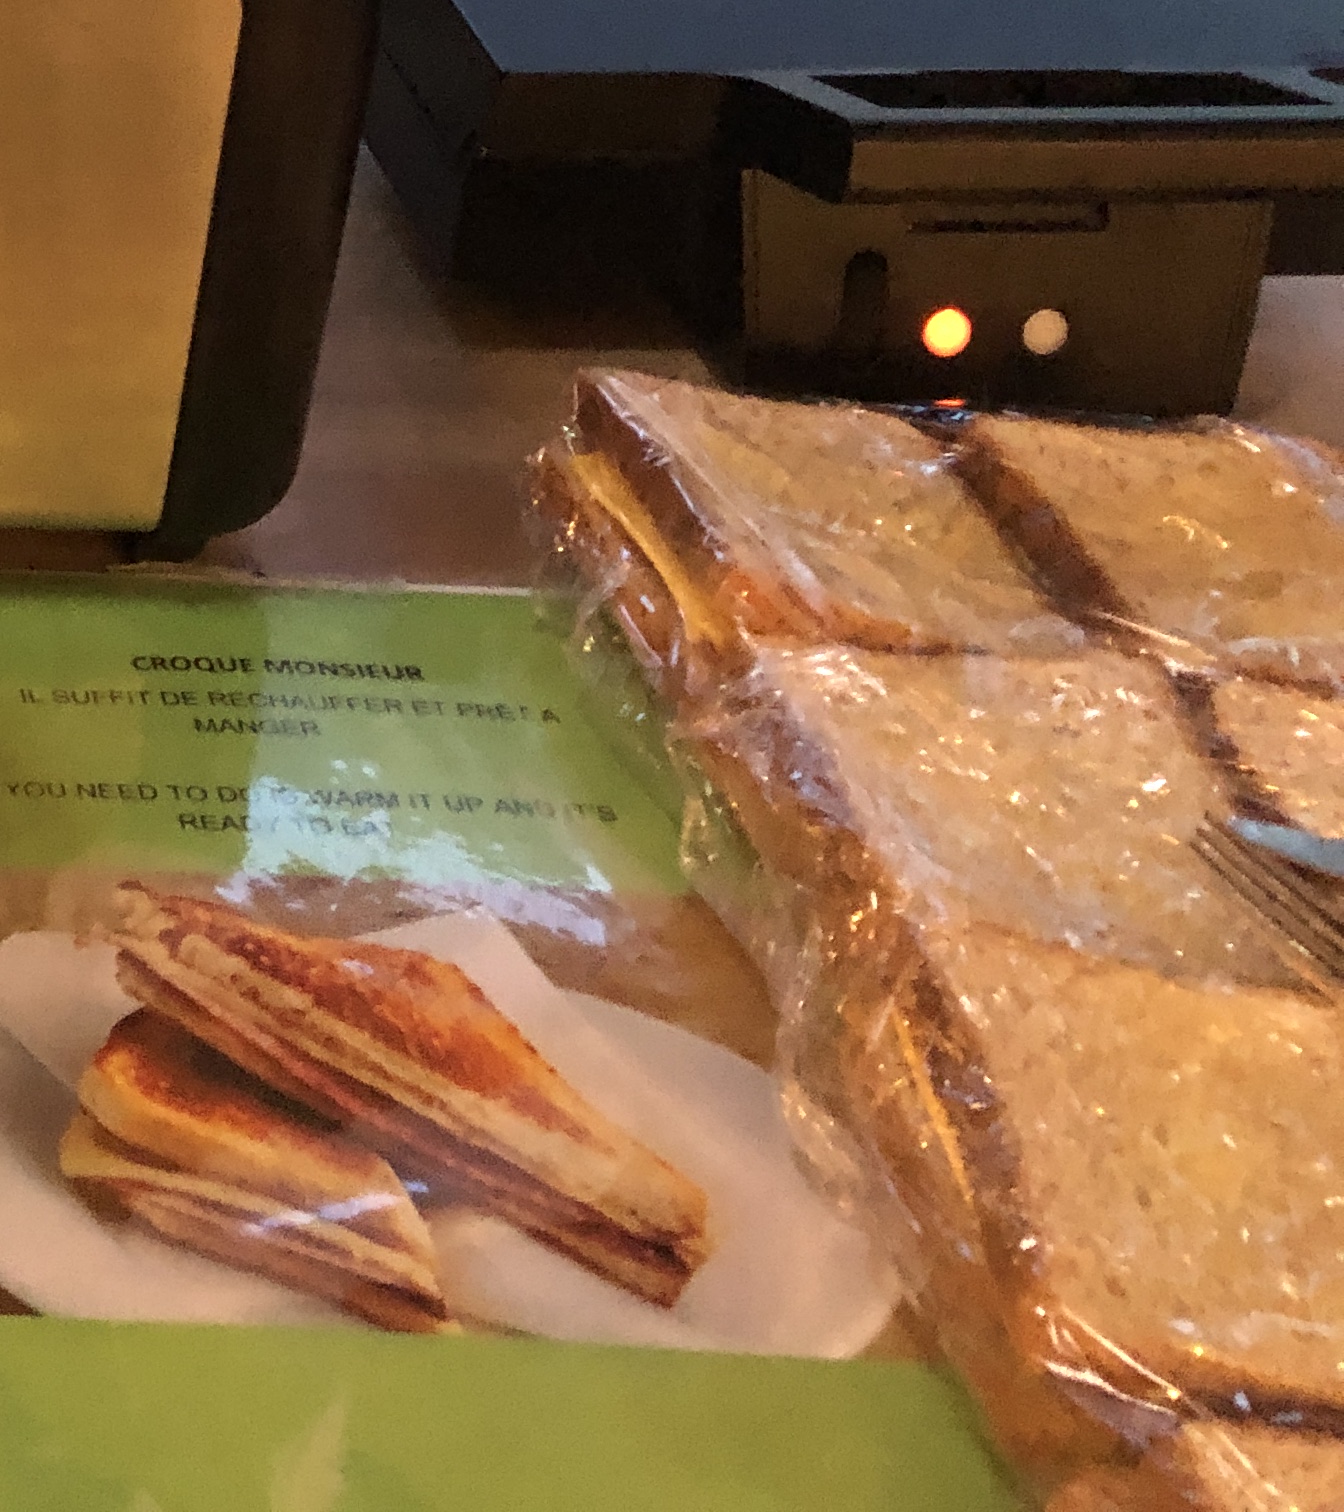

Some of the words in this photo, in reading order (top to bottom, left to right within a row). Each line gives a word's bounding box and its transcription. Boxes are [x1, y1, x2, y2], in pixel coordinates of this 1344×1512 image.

[129, 655, 256, 674] CROQUE
[263, 658, 425, 682] MONSIEUR
[18, 688, 40, 705] IL
[50, 688, 150, 706] SUFFIT
[159, 690, 199, 707] DE
[411, 698, 445, 716] ET
[193, 716, 323, 737] MANGER
[6, 781, 68, 800] YOU
[75, 781, 159, 803] NEED
[165, 783, 209, 803] TO
[306, 788, 401, 809] WARM
[408, 792, 432, 812] IT
[442, 793, 484, 815] UP
[493, 797, 557, 819] AND
[340, 815, 396, 838] EA
